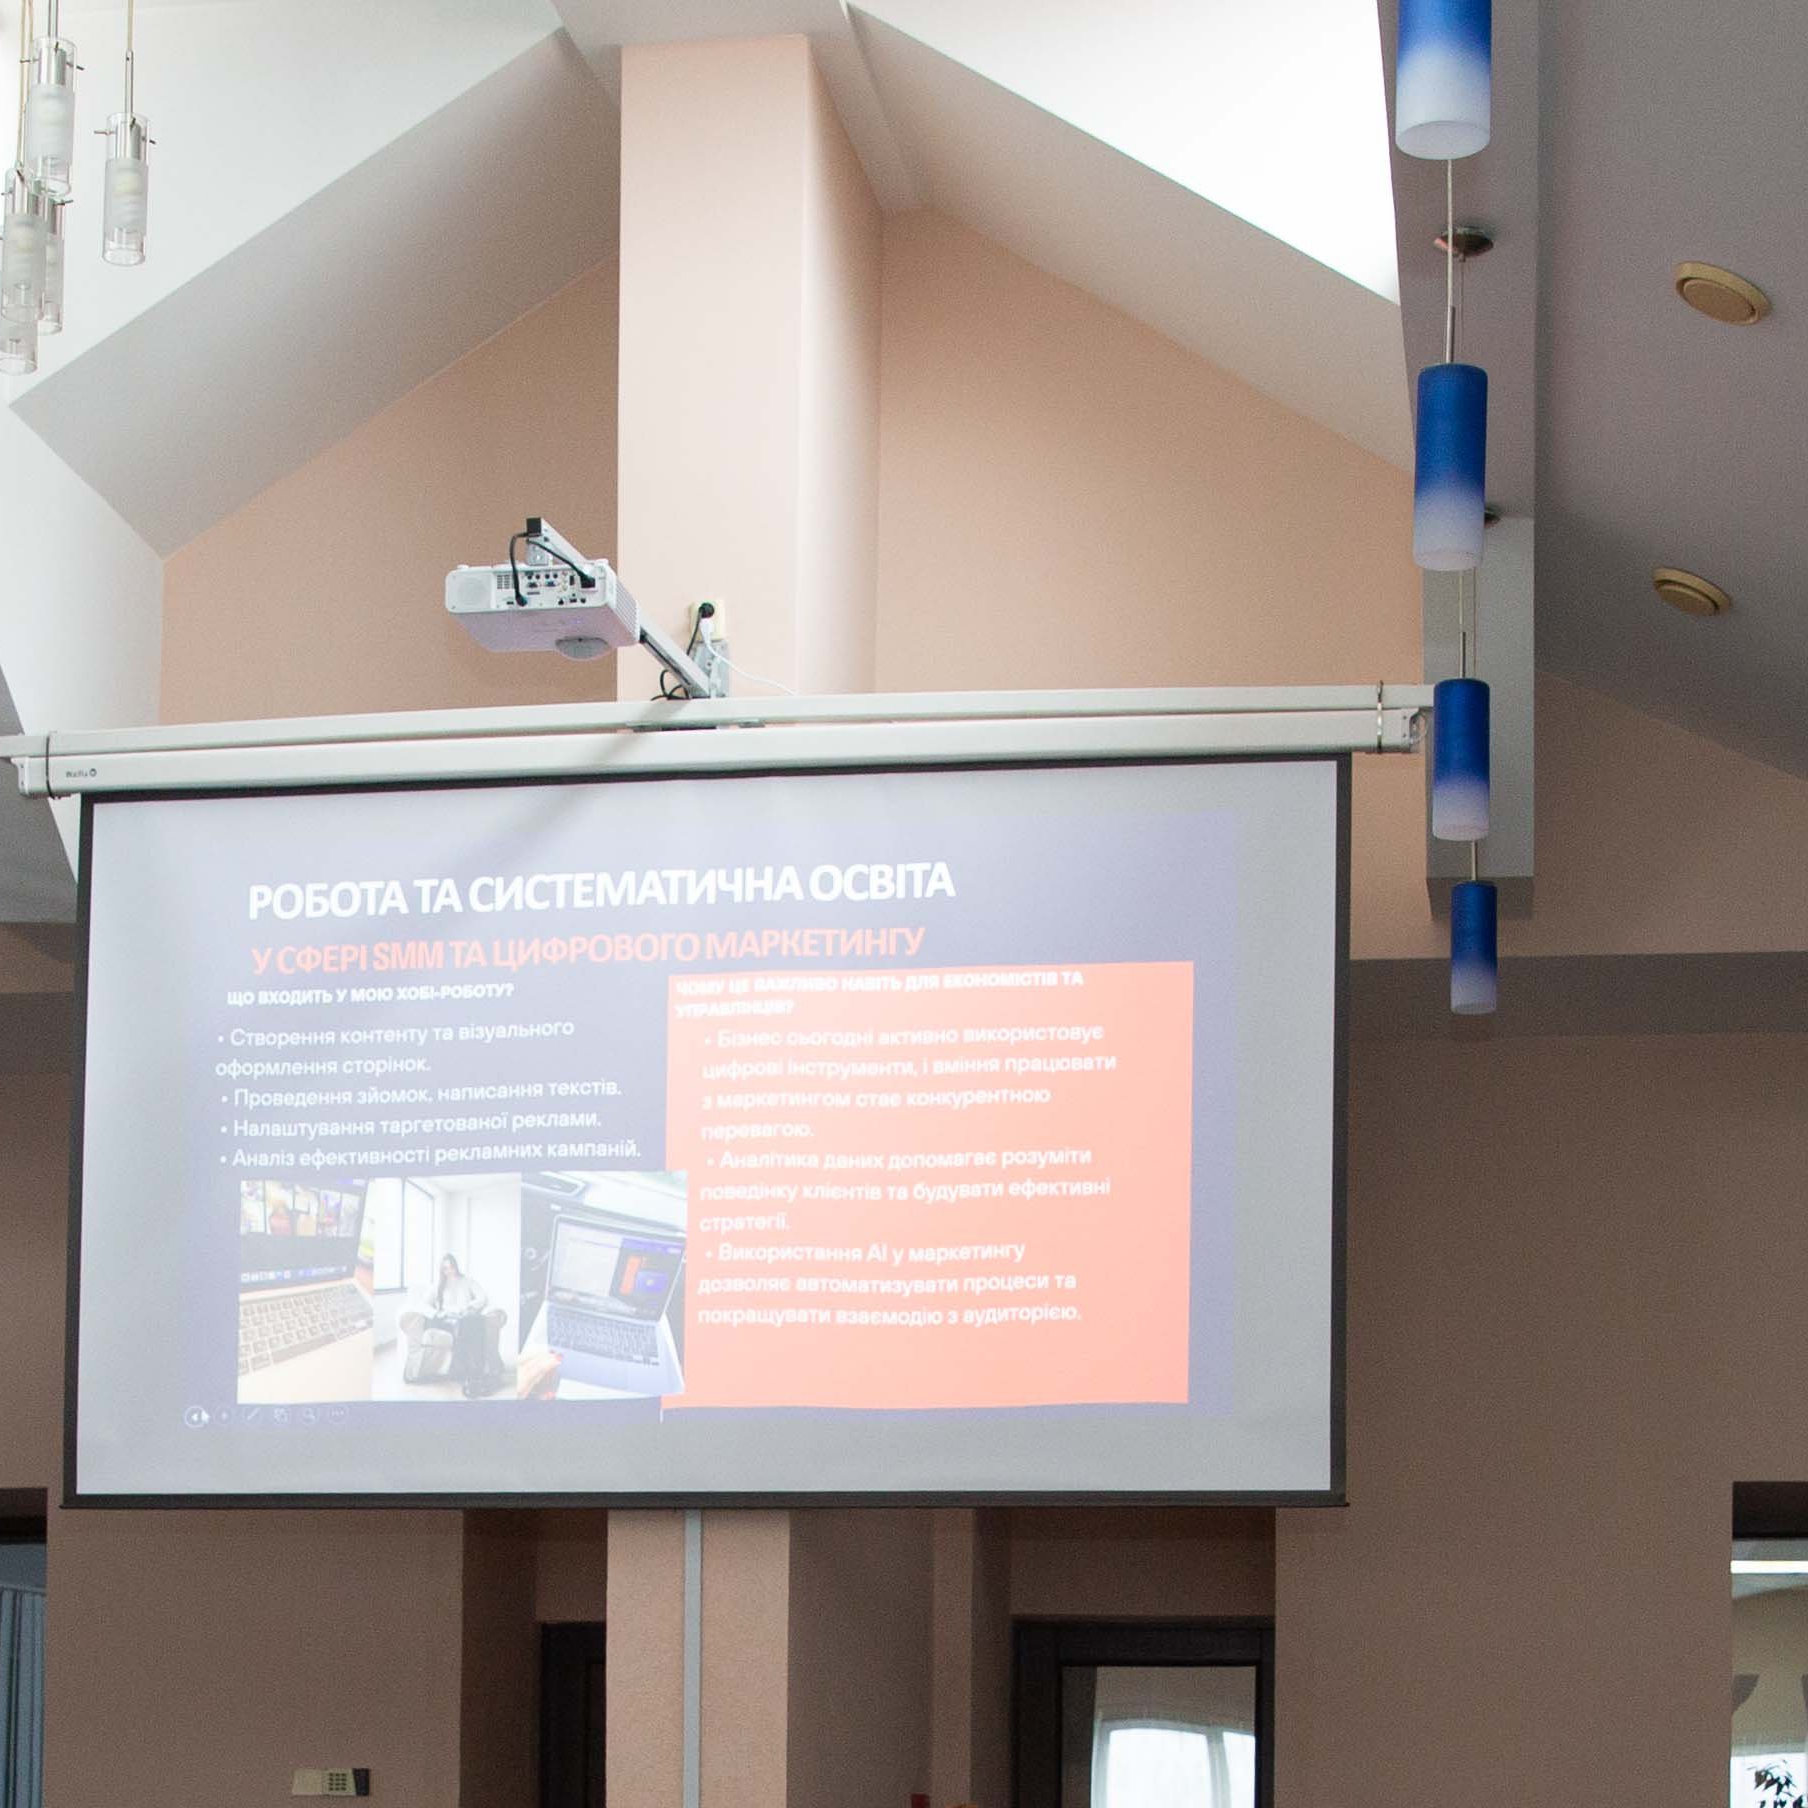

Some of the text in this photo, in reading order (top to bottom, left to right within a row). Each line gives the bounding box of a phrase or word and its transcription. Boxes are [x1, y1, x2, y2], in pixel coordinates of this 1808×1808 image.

[249, 862, 956, 920] РОБОТА ТА СИСТЕМАТИЧНА ОСВІТА
[252, 927, 925, 975] У СФЕРІ SMM ТА ЦИФРОВОГО МАРКЕТИНГУ
[905, 974, 940, 992] ДЛЯ
[1061, 972, 1083, 986] ТА
[227, 990, 254, 1006] ЩО
[258, 988, 332, 1006] ВХОДИТЬ
[351, 986, 392, 1002] МОЮ
[396, 983, 515, 1001] ХОБІ-РОБОТУ?
[230, 1020, 574, 1048] Створення контенту та візуального
[717, 1030, 782, 1047] Бізнес
[879, 1028, 958, 1045] активно
[962, 1025, 1105, 1045] використовує
[216, 1056, 431, 1080] оформлення сторінок.
[934, 1058, 999, 1072] вміння
[1004, 1056, 1116, 1075] працювати
[234, 1088, 351, 1109] Проведення
[438, 1083, 543, 1102] написання
[549, 1078, 621, 1096] текстів.
[907, 1087, 1051, 1110] конкурентною
[233, 1113, 601, 1141] Налаштування таргетованої реклами.
[232, 1138, 640, 1171] Аналіз ефективності рекламних кампаній.
[720, 1148, 1091, 1171] Аналітика даних допомагає розуміти
[700, 1183, 798, 1203] поведінку
[886, 1186, 908, 1200] та
[913, 1182, 1004, 1203] будувати
[1008, 1178, 1110, 1199] ефективні
[719, 1244, 861, 1264] Використання
[908, 1242, 1025, 1264] маркетингу
[963, 1275, 1049, 1295] процеси
[1055, 1275, 1076, 1289] та
[963, 1304, 1081, 1325] аудиторією.
